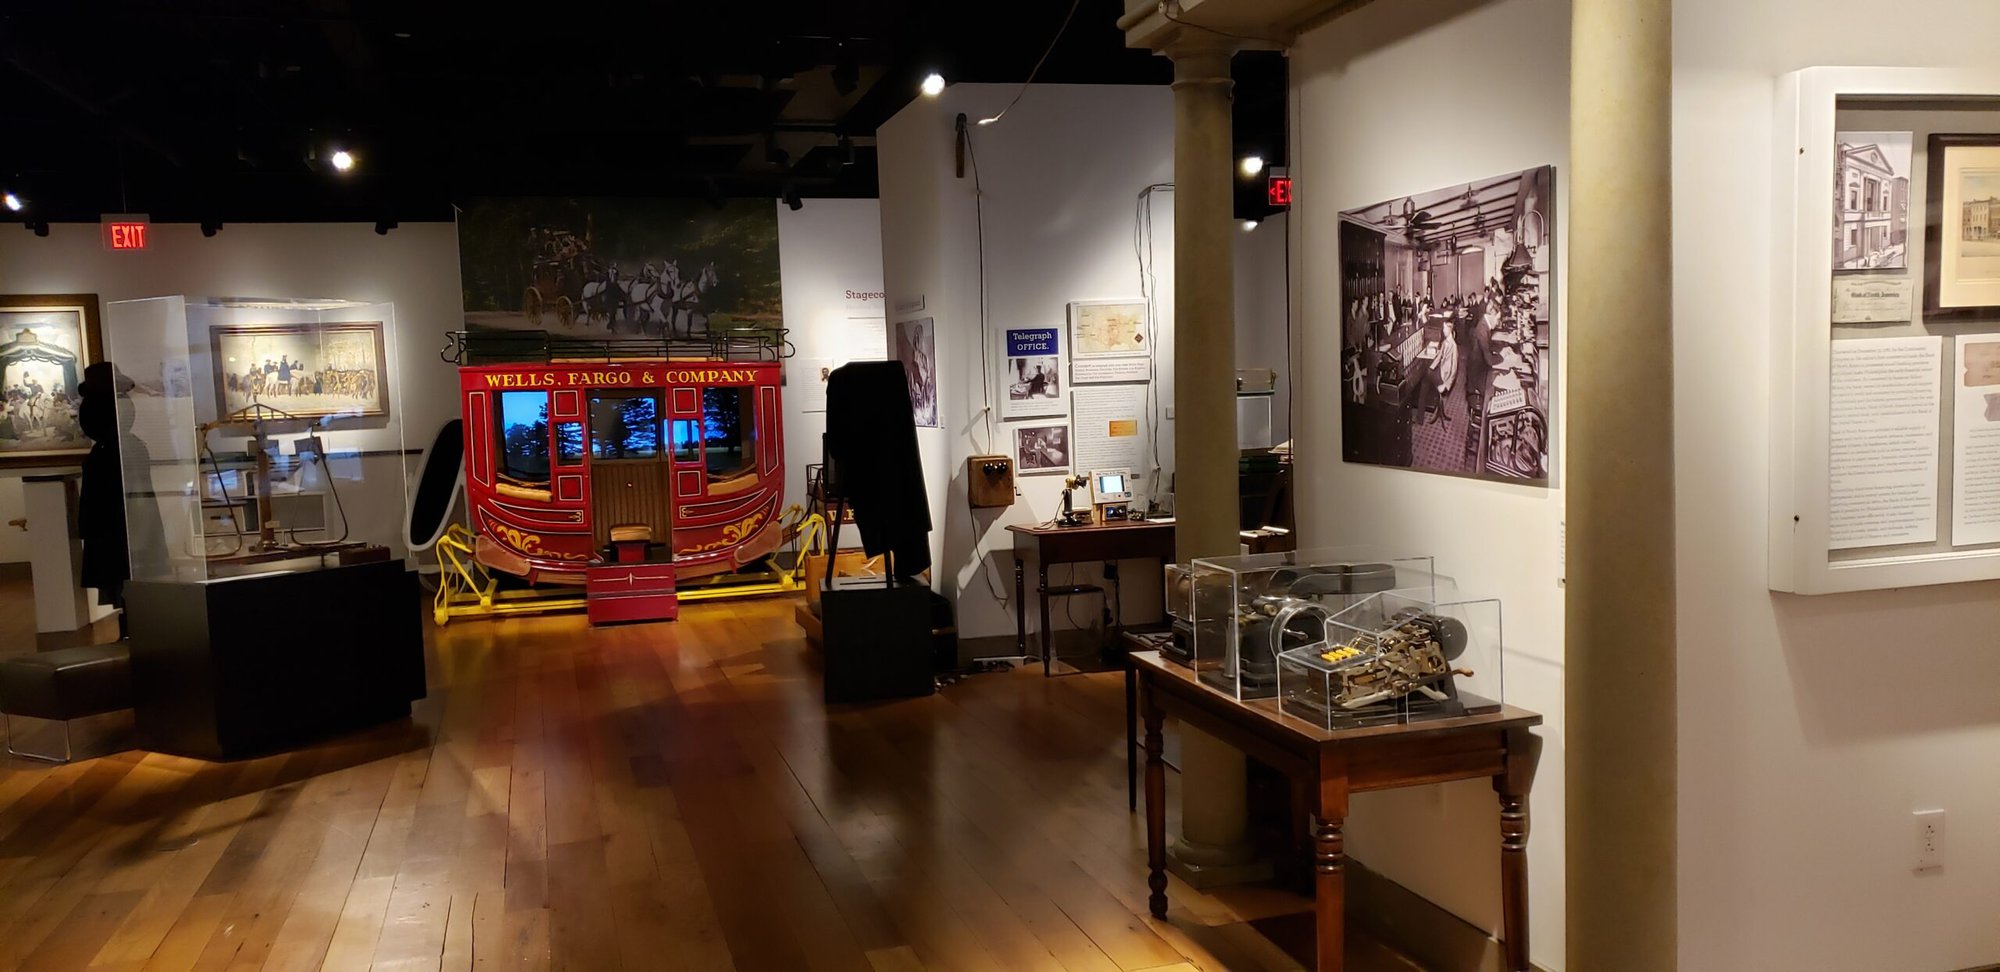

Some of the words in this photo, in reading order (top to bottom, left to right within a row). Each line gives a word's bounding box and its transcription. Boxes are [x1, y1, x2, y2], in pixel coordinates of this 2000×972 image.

[111, 225, 144, 248] EXIT
[1012, 332, 1053, 341] Telegraph
[1017, 343, 1050, 351] OFFICE.
[567, 371, 631, 386] FARGO
[642, 371, 655, 384] &
[665, 370, 759, 384] COMPANY
